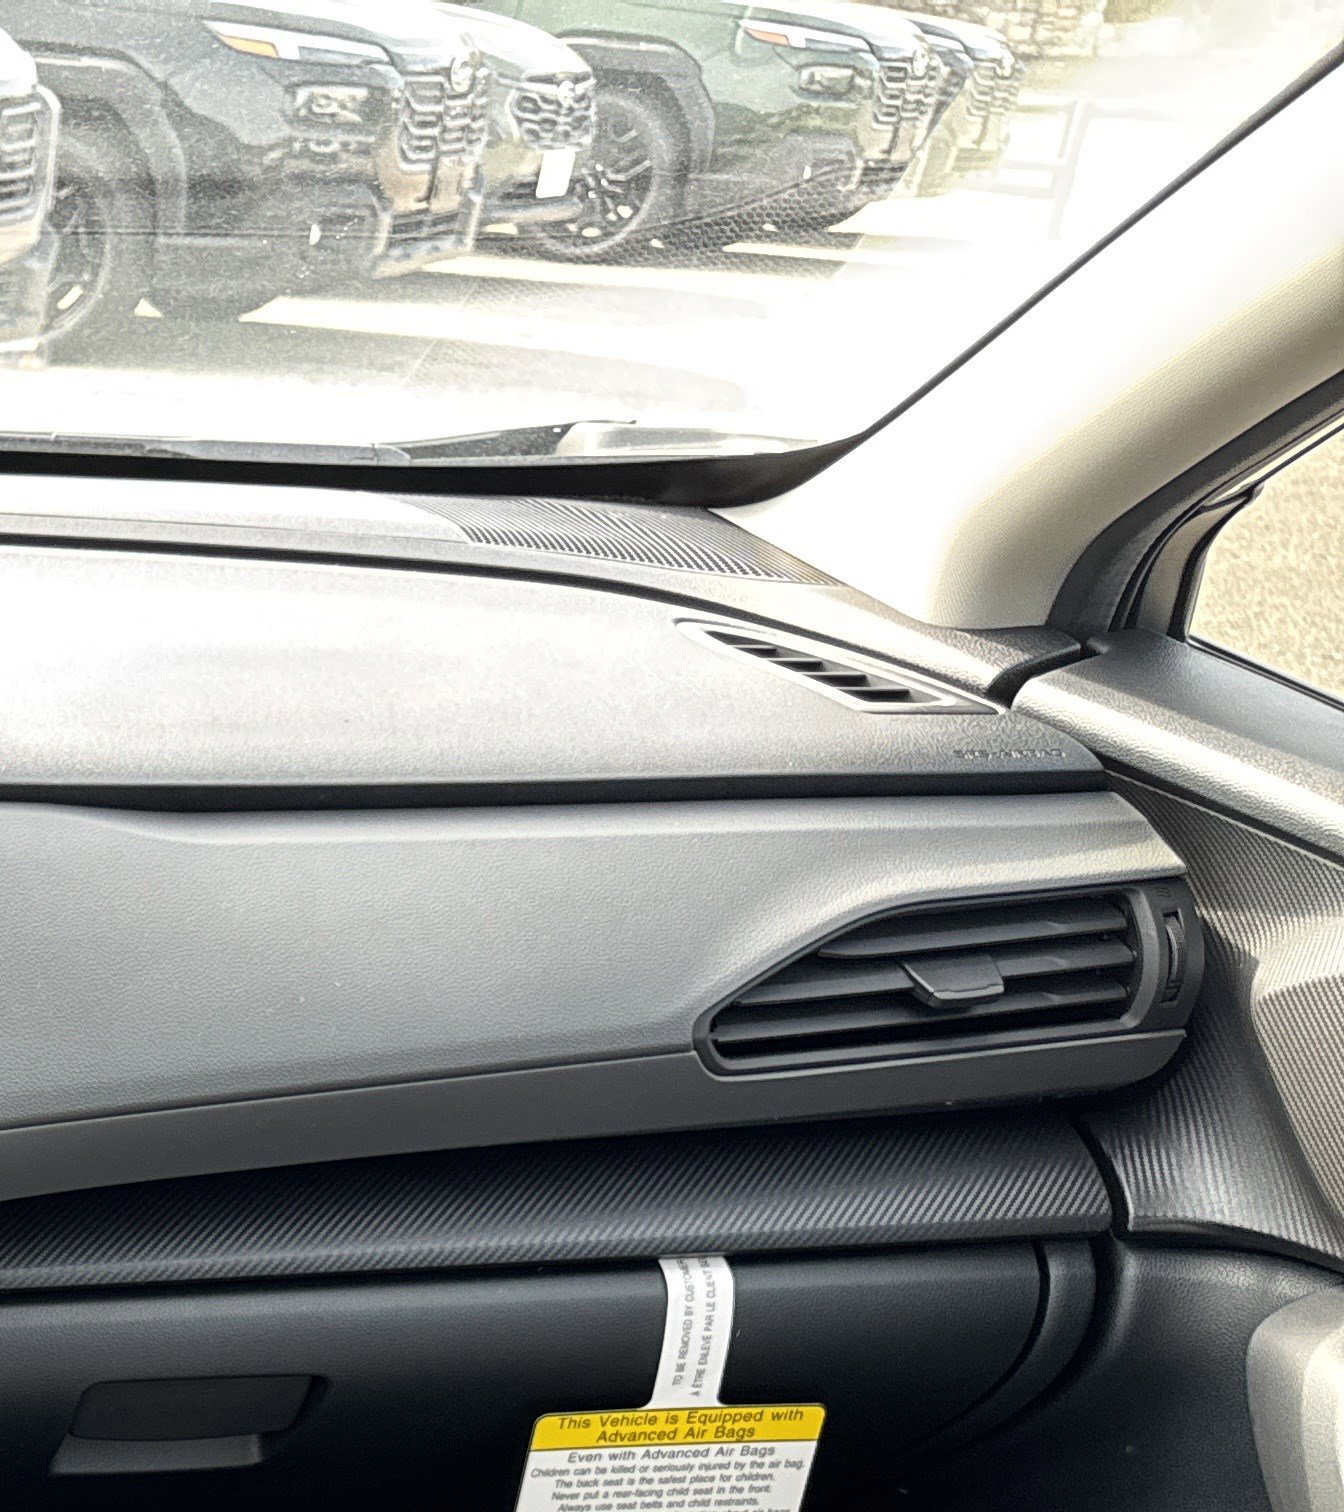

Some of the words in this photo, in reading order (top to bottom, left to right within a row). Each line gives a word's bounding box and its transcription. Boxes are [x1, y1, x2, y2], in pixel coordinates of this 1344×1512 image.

[558, 1417, 591, 1429] This
[599, 1413, 657, 1427] Vehicle
[664, 1412, 679, 1424] is
[686, 1409, 764, 1425] Equipped
[771, 1408, 803, 1421] with
[596, 1428, 678, 1443] Advanced
[683, 1426, 708, 1439] Air
[714, 1426, 756, 1441] Bags
[568, 1452, 602, 1463] Even
[608, 1450, 635, 1460] with
[641, 1447, 710, 1460] Advanced
[715, 1446, 735, 1457] Air
[740, 1445, 775, 1458] Bags
[595, 1466, 607, 1475] be
[639, 1465, 649, 1473] or
[734, 1461, 746, 1471] by
